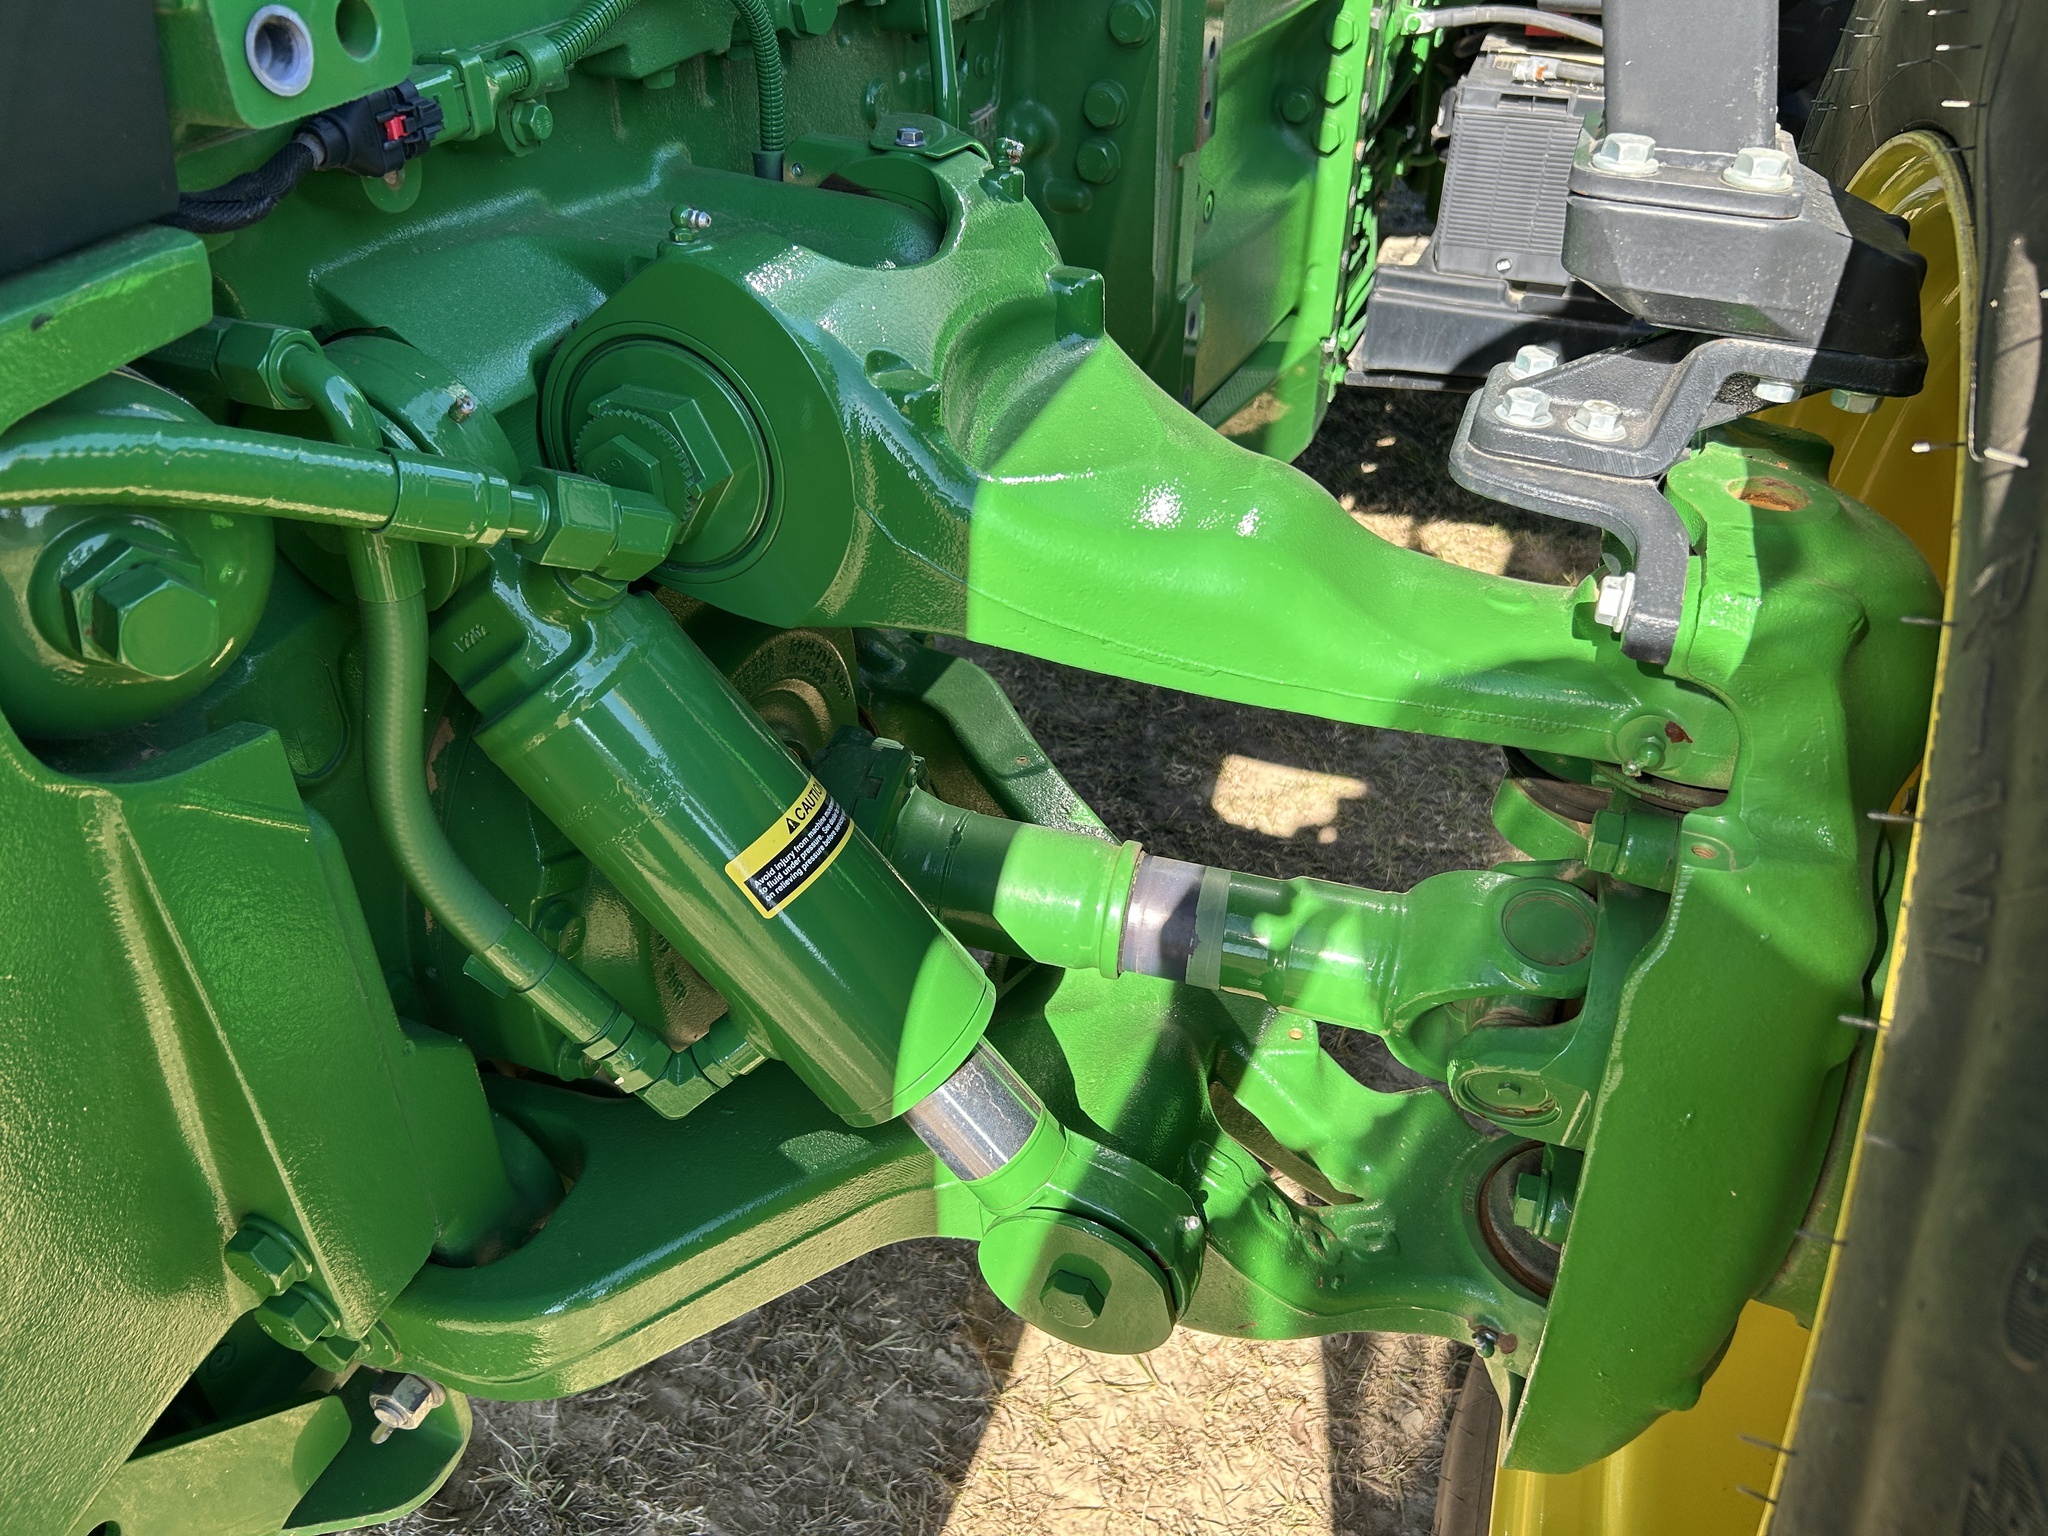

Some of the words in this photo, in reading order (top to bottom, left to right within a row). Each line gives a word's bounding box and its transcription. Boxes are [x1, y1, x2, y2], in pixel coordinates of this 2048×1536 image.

[754, 867, 776, 888] Avoid
[774, 851, 796, 871] injury
[794, 836, 809, 852] from
[808, 816, 826, 839] machine
[759, 886, 768, 895] to
[767, 873, 784, 889] fluid
[783, 857, 801, 875] under
[800, 834, 824, 860] pressure.
[821, 823, 831, 834] See
[765, 892, 776, 901] on
[775, 868, 803, 894] relieving
[801, 845, 825, 871] pressure
[823, 830, 837, 847] before
